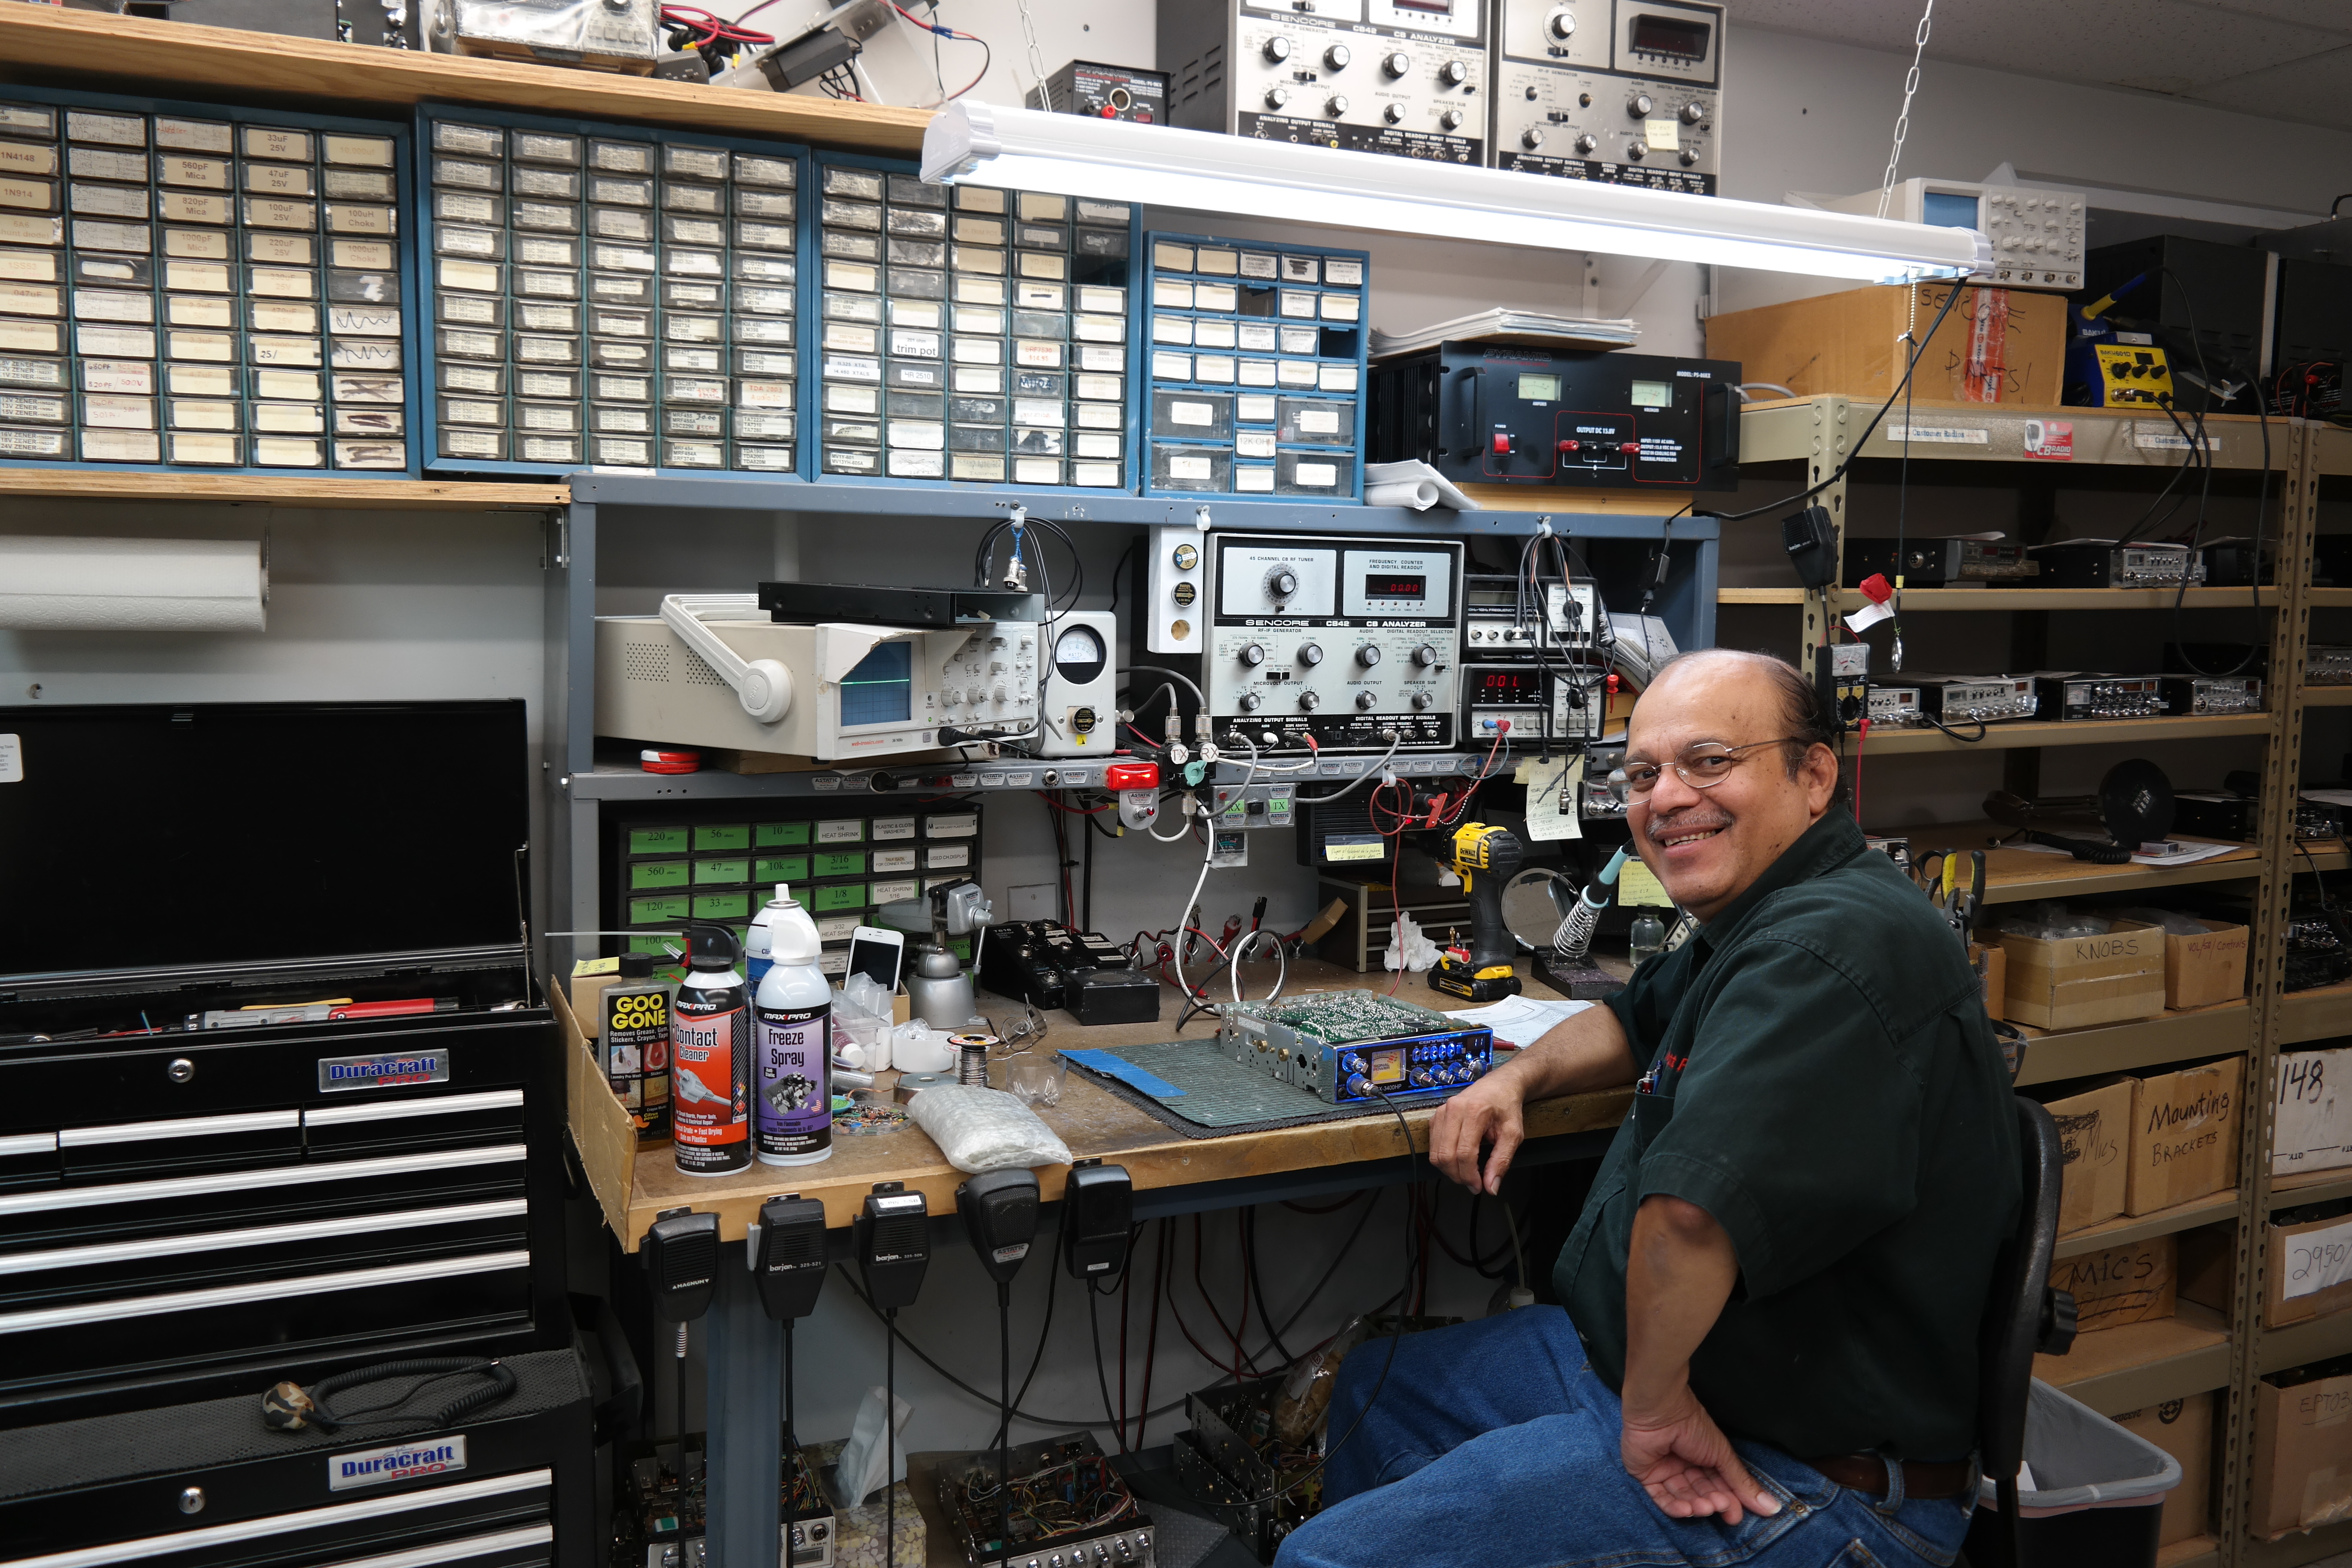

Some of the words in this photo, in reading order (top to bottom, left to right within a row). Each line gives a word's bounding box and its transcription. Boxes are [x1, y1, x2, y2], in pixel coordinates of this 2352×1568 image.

[1271, 14, 1336, 28] SENCORE
[1299, 26, 1328, 34] GENERATOR
[1353, 25, 1377, 34] CB42
[1410, 33, 1455, 45] ANALYZER
[1259, 115, 1289, 124] ANALYZING
[267, 134, 288, 143] 33uF
[1446, 136, 1466, 144] SIGNALS
[270, 144, 286, 153] 25V
[0, 152, 35, 162] 1N4148
[182, 162, 208, 170] 560pF
[186, 172, 206, 180] Mica
[4, 188, 33, 198] 1N914
[183, 197, 208, 207] 820pF
[186, 207, 206, 215] Mica
[268, 204, 294, 212] 100uF
[348, 210, 374, 218] 100uH
[349, 219, 375, 227] Choke
[182, 234, 212, 243] 1000pF
[270, 239, 294, 248] 220uF
[348, 245, 378, 254] 1000uH
[350, 255, 377, 263] Choke
[897, 344, 916, 355] trim
[920, 346, 936, 356] pot
[1483, 349, 1552, 361] PYRAMID
[916, 371, 931, 380] 2510
[2037, 444, 2051, 456] CB
[1172, 750, 1187, 761] TX
[1201, 748, 1219, 759] RX
[1273, 802, 1285, 810] TX
[711, 829, 722, 838] 56
[773, 827, 782, 835] 10
[648, 832, 665, 841] 220
[831, 855, 849, 864] 3/16
[710, 863, 722, 871] 47
[769, 862, 784, 870] 10k
[647, 867, 664, 876] 560
[835, 890, 847, 898] 1/8
[646, 902, 663, 911] 120
[710, 899, 720, 907] 33
[2076, 939, 2139, 960] KNOBS
[616, 994, 663, 1012] GOO
[612, 1009, 666, 1029] GONE
[676, 1023, 718, 1047] Contact
[769, 1029, 804, 1045] Freeze
[680, 1045, 709, 1062] Cleaner
[772, 1048, 804, 1067] Spray
[331, 1056, 437, 1079] Duracraft
[377, 1073, 431, 1086] PRO
[2280, 1059, 2324, 1105] 148
[2147, 1089, 2230, 1133] Mounting
[2152, 1131, 2217, 1167] BRACKETS
[997, 1245, 1025, 1255] ASTATIC
[876, 1253, 899, 1262] barjan
[769, 1264, 793, 1272] barjan
[677, 1280, 705, 1289] MAGNUM
[342, 1446, 454, 1478] Duracraft
[391, 1463, 446, 1479] PRO
